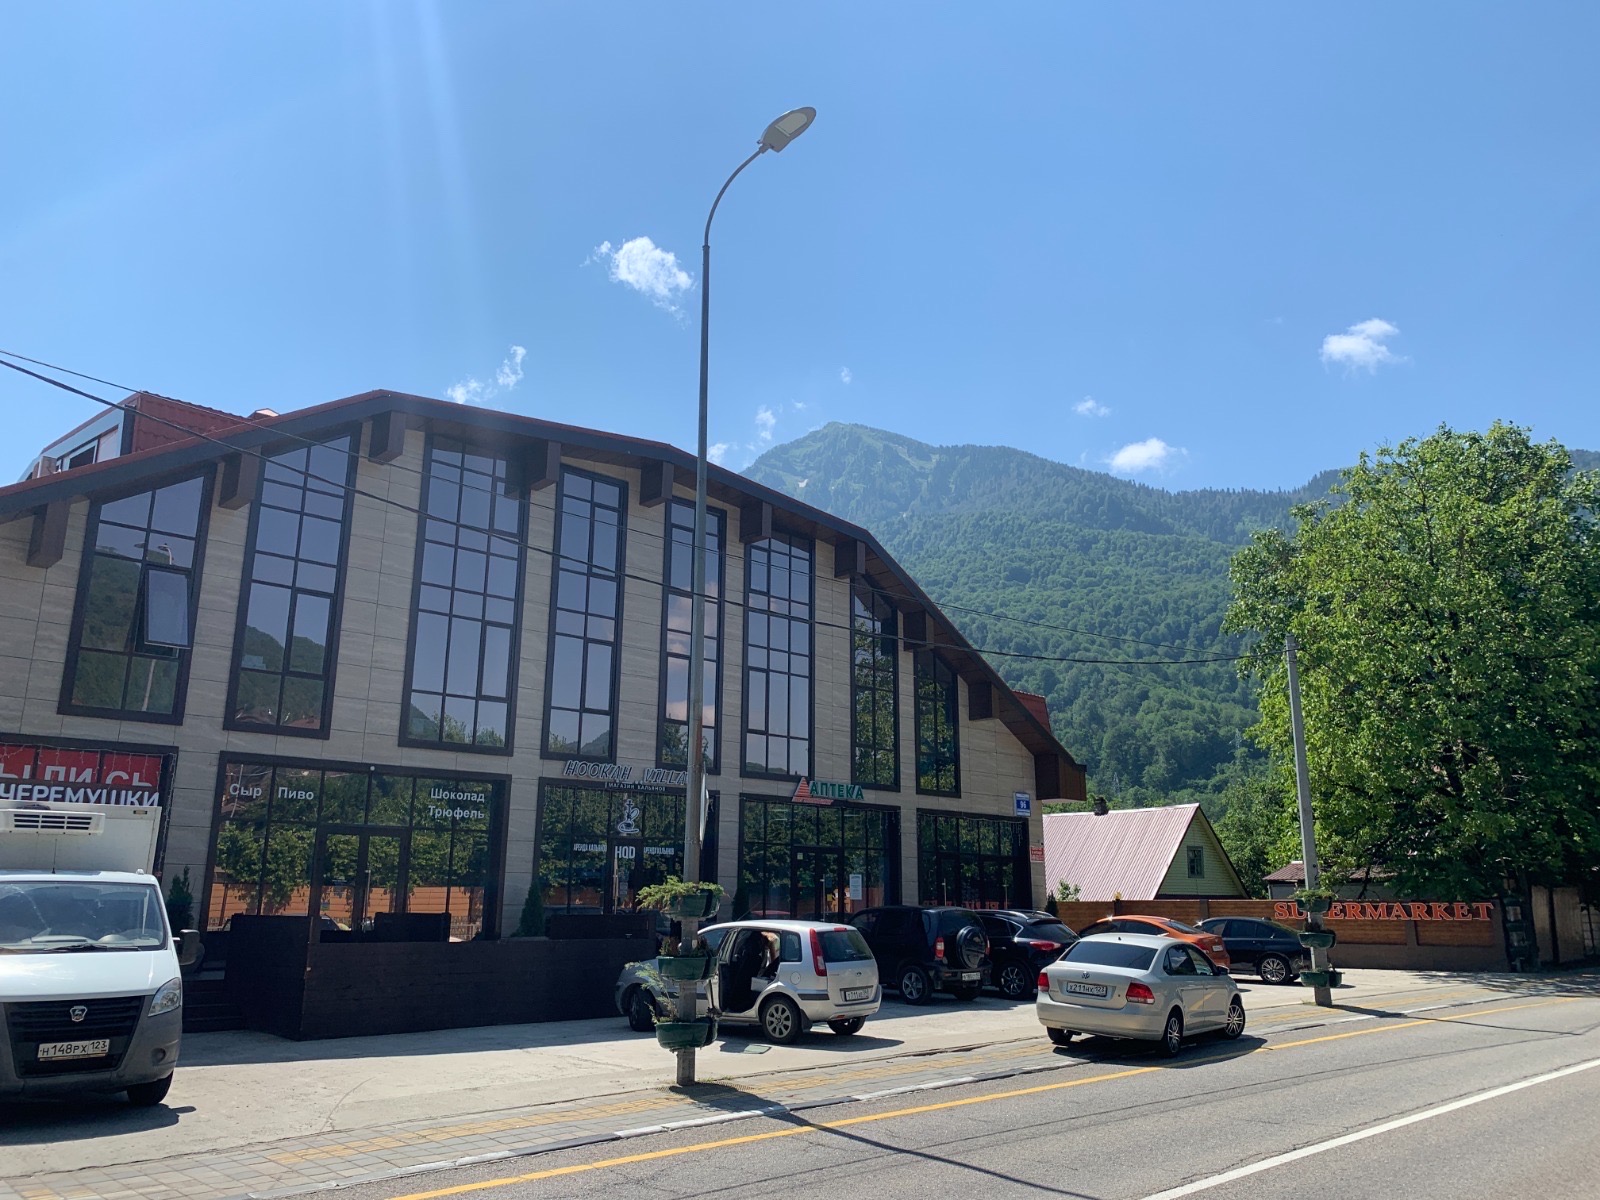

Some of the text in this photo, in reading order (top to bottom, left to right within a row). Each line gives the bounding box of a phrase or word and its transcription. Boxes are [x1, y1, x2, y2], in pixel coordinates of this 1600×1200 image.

[564, 760, 690, 787] HOOKAH VILLA
[0, 783, 160, 806] ЧЕРЕМУШКИ
[229, 783, 314, 800] Сыр Пиво
[430, 788, 485, 803] Шоколад
[810, 782, 864, 799] АПТЕКА
[428, 805, 485, 820] Трюфель
[614, 845, 636, 859] HQD
[1274, 901, 1494, 921] SUERMARKET
